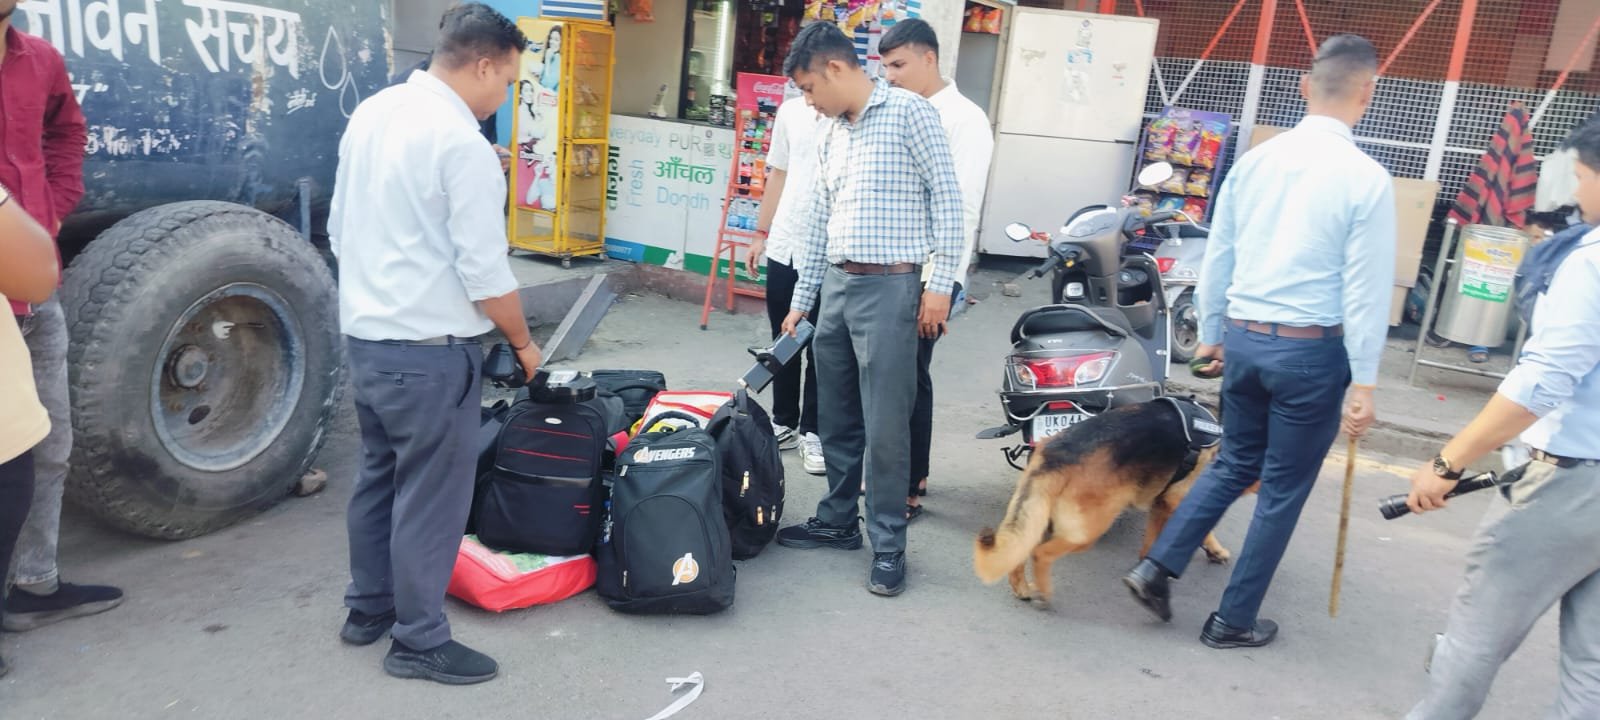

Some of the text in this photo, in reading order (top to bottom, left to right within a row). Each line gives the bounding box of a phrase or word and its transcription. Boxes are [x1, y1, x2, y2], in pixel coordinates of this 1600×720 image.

[669, 132, 702, 152] PUR
[628, 159, 644, 207] Fresh
[633, 446, 696, 463] AVENGERS
